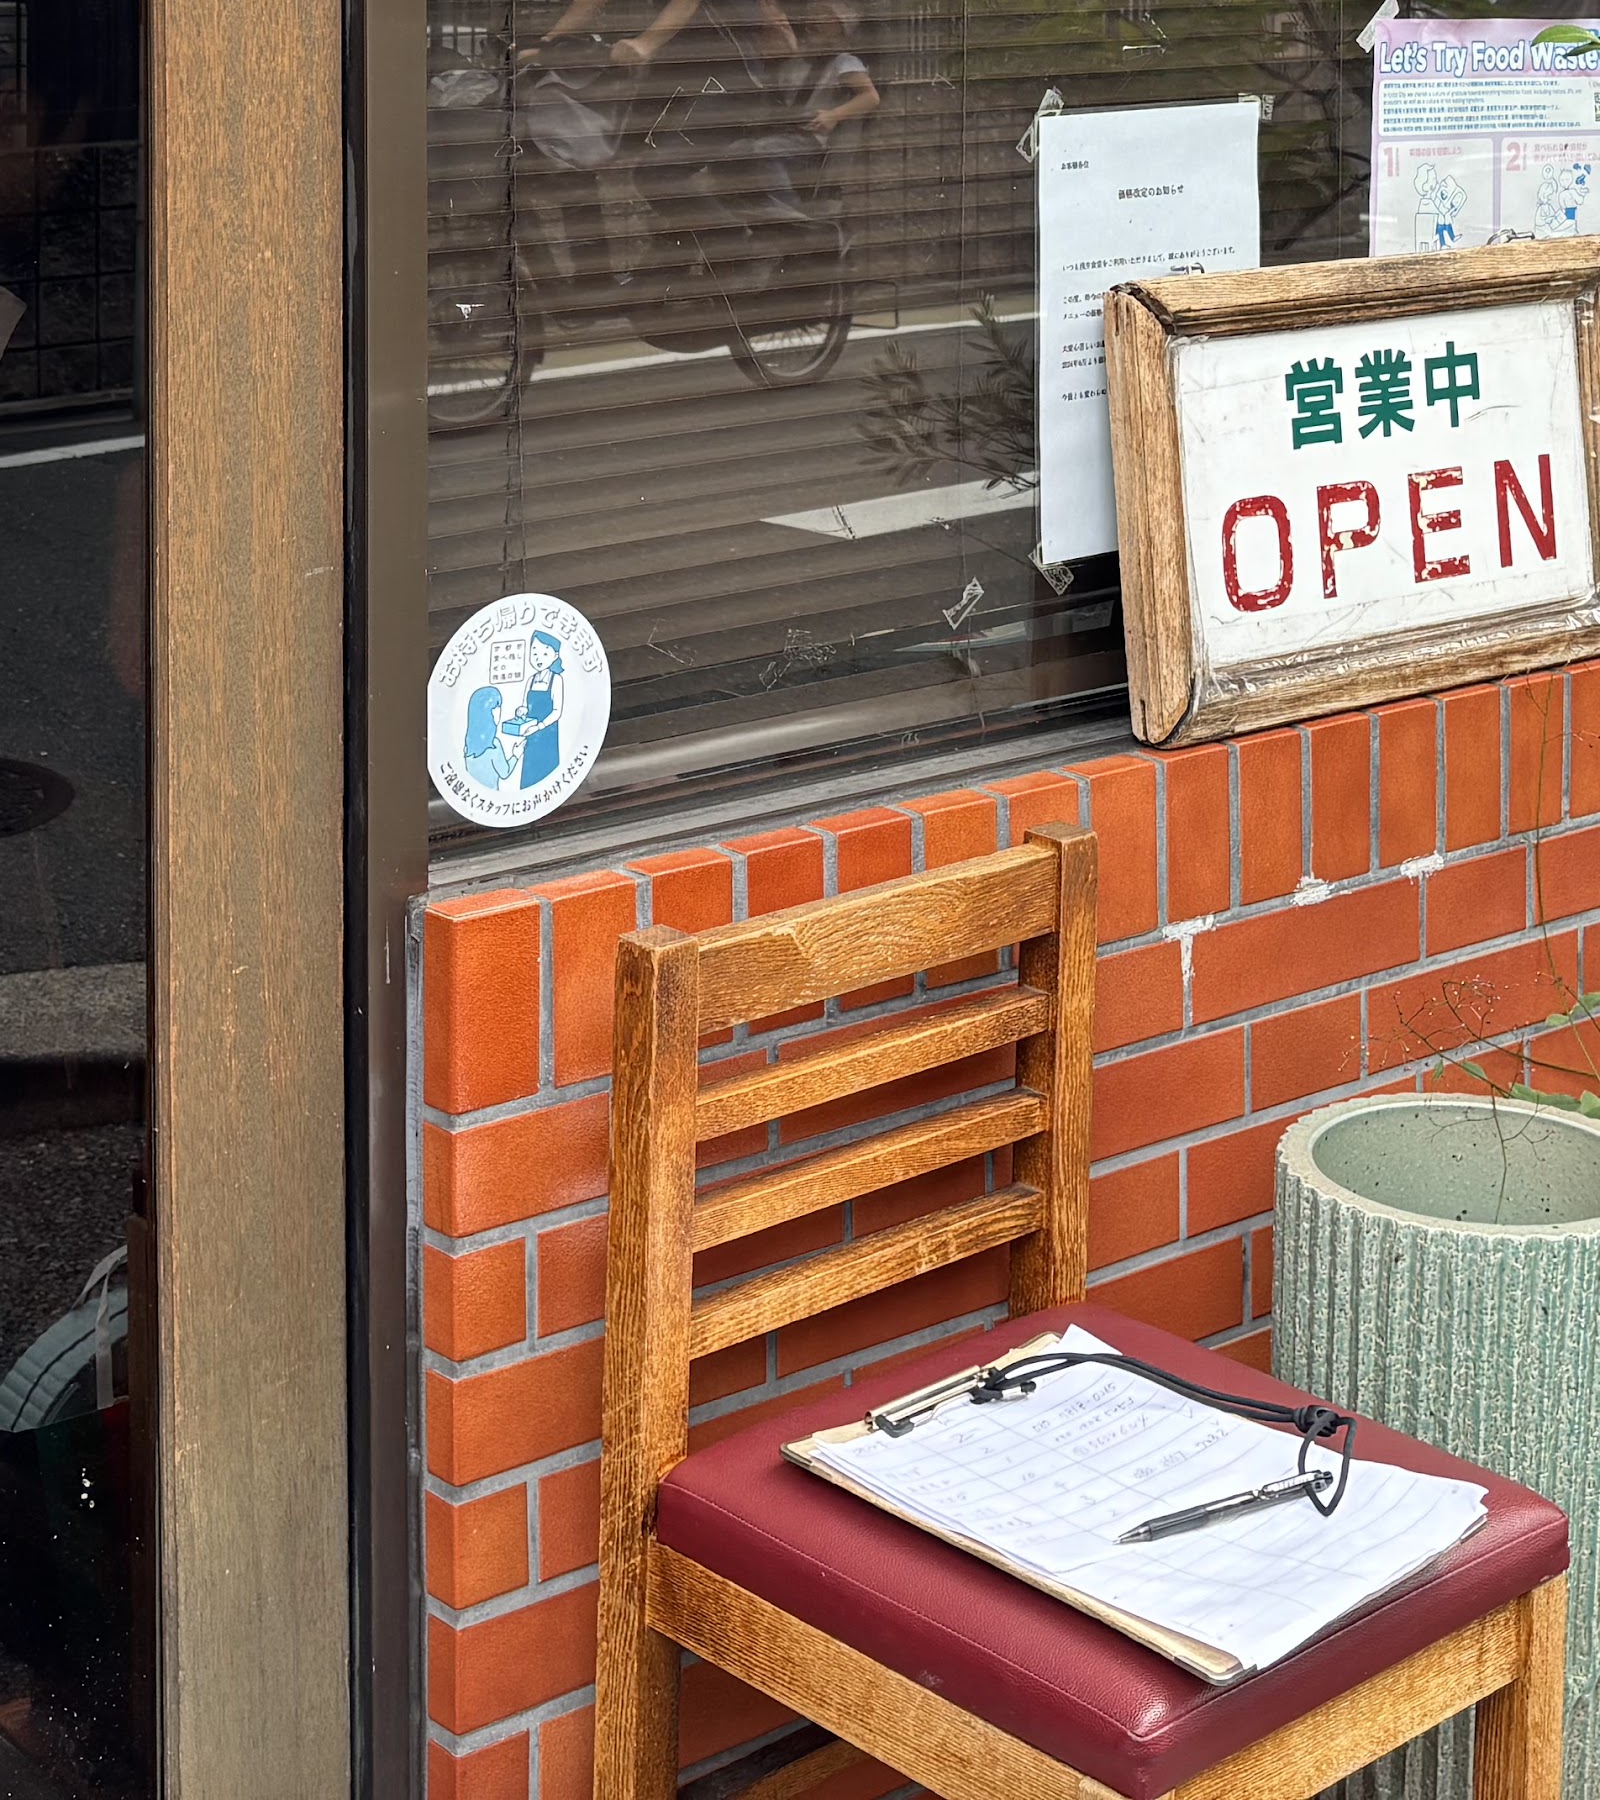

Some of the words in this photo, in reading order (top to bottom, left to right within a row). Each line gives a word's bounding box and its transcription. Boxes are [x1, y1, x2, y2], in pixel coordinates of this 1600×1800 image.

[1379, 41, 1428, 74] Let's
[1432, 41, 1467, 77] Try
[1471, 39, 1525, 72] Food
[1530, 40, 1599, 71] Waste
[1506, 141, 1521, 172] 2
[1117, 184, 1185, 201] 価格改定のお知らせ
[1284, 340, 1481, 450] 営業中
[1221, 453, 1558, 613] OPEN
[438, 601, 605, 688] お持ち帰りできます
